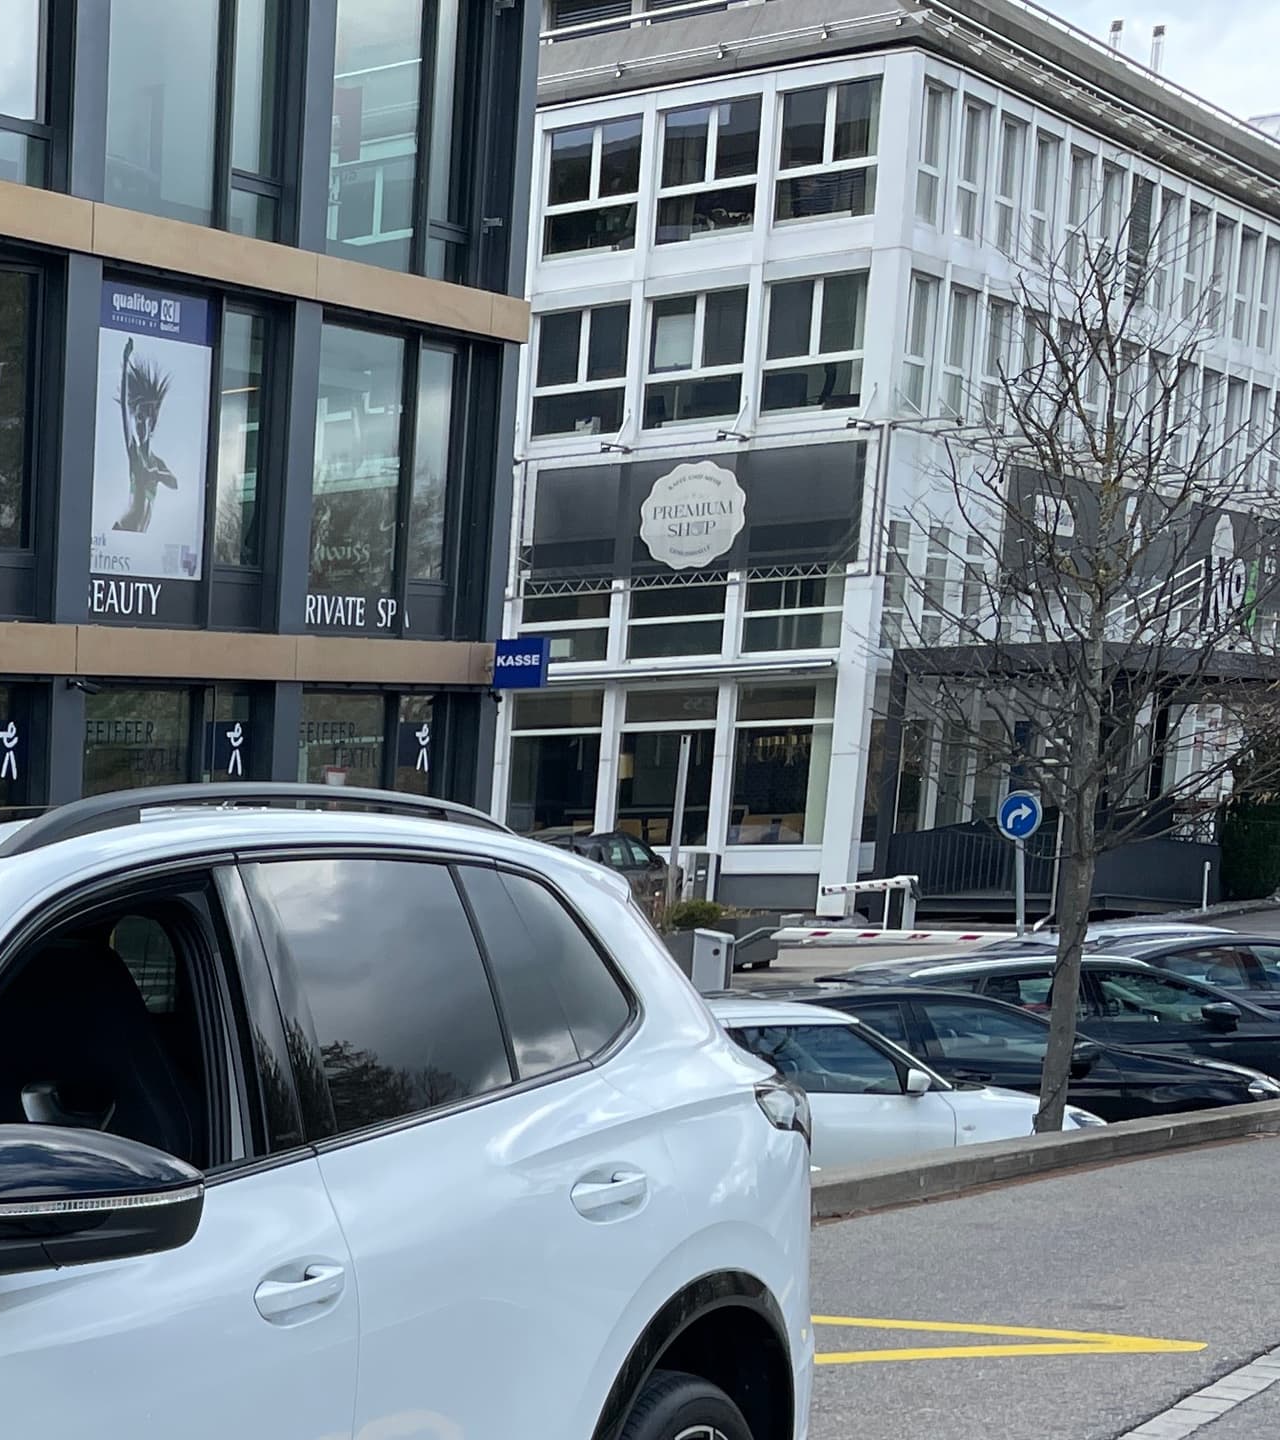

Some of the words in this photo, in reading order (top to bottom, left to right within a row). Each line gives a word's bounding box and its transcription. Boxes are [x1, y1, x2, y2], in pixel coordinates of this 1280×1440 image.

[112, 293, 159, 317] qualitop
[653, 500, 735, 521] PREMIUM
[91, 533, 107, 547] ark
[667, 521, 717, 538] SHOP
[87, 579, 162, 615] EAUTY
[377, 597, 410, 629] SP
[496, 653, 541, 669] KASSE
